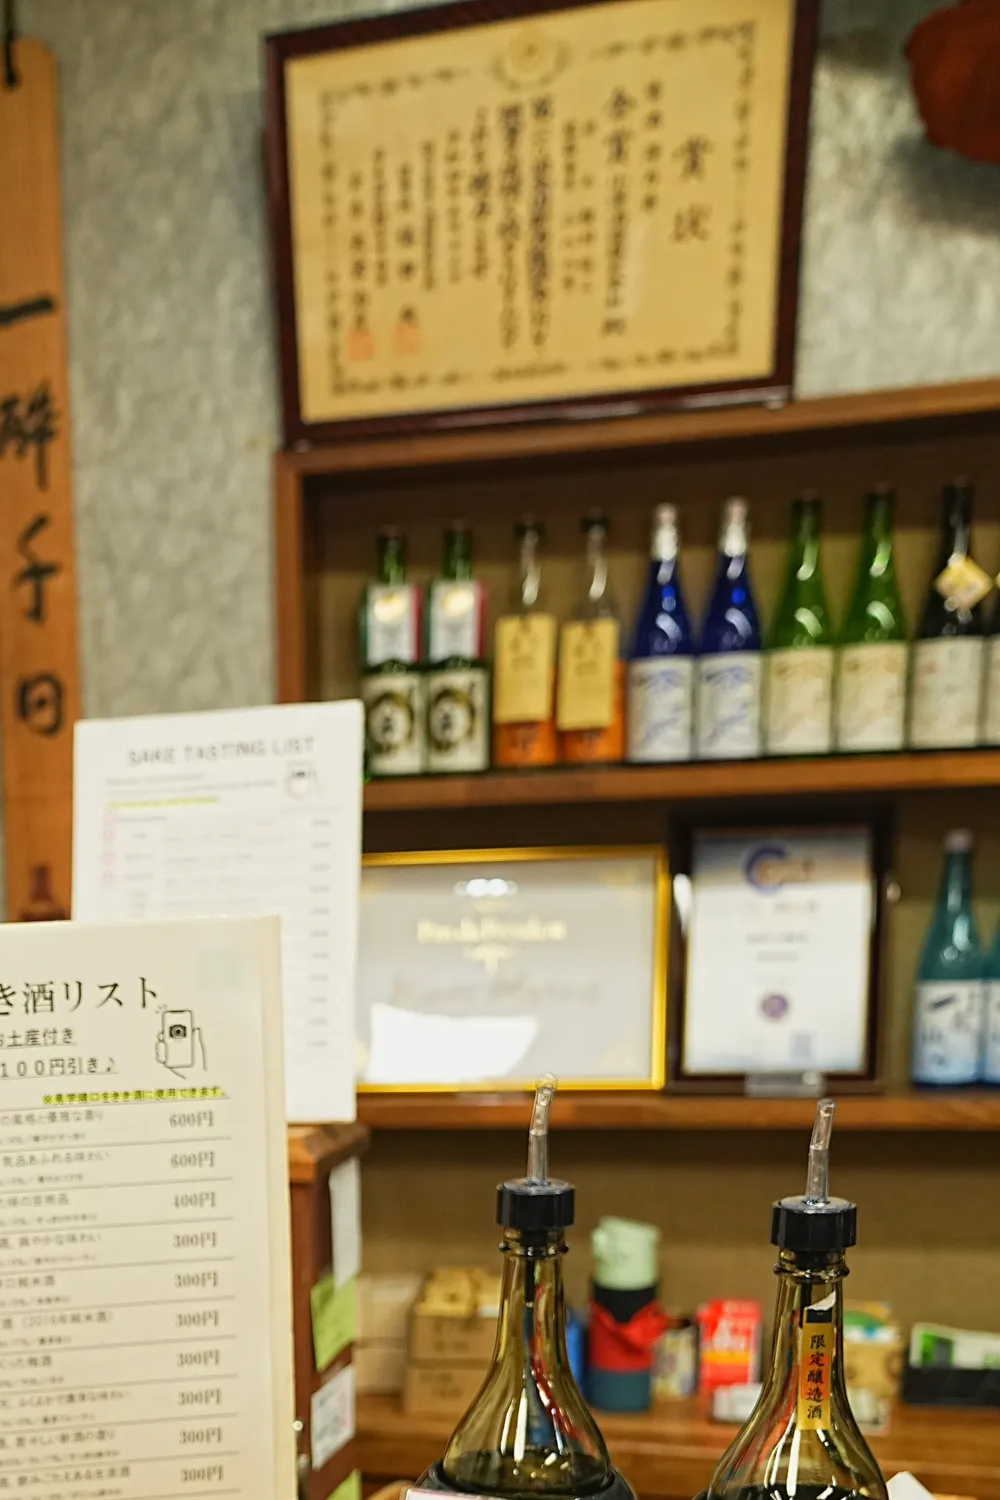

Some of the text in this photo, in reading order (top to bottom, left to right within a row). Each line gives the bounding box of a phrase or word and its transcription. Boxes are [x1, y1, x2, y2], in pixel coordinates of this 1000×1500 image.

[127, 737, 315, 766] SAKE TASTING LIST
[169, 1110, 214, 1127] 600円
[170, 1151, 215, 1168] 600円
[172, 1191, 217, 1209] 400円
[173, 1231, 217, 1248] 300円
[174, 1271, 218, 1288] 300円
[175, 1310, 219, 1327] 300円
[176, 1349, 220, 1367] 300円
[806, 1334, 826, 1420] 限定醸造酒
[178, 1388, 222, 1406] 300円
[179, 1427, 222, 1444] 300円
[180, 1465, 223, 1482] 300円
